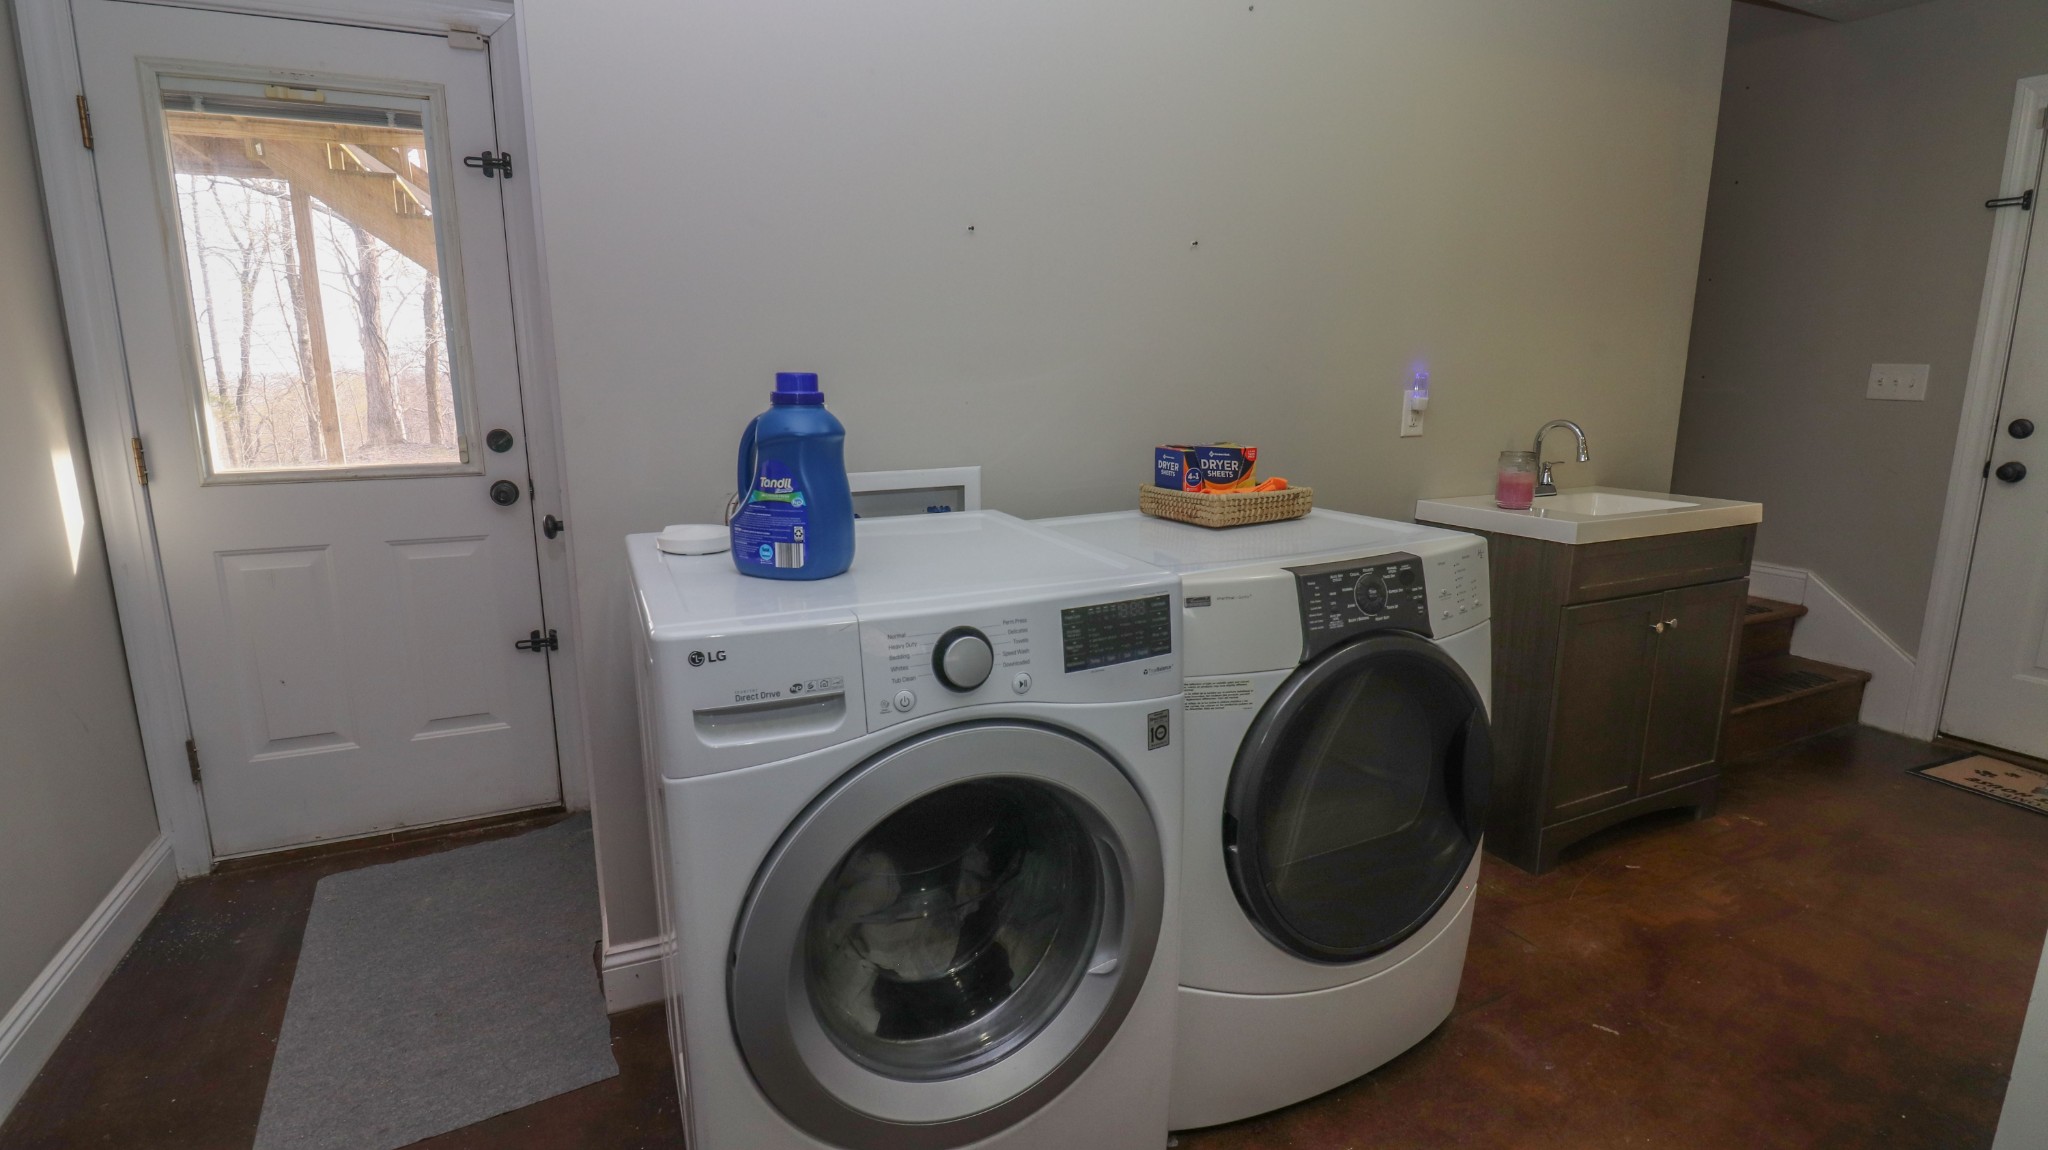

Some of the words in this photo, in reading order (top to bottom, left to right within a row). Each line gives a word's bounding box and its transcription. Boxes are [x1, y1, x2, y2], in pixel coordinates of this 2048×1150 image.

[1158, 460, 1179, 471] DRYER
[1201, 459, 1239, 470] DRYER
[1207, 470, 1233, 478] SHEETS
[760, 476, 792, 489] Tandil
[888, 643, 905, 651] Heavy
[905, 641, 918, 649] Duty
[707, 650, 727, 663] LG
[889, 653, 911, 661] Bedding
[1002, 659, 1031, 668] Downloaded
[901, 675, 917, 683] Clean
[735, 692, 759, 702] Direct
[760, 690, 781, 700] Drive
